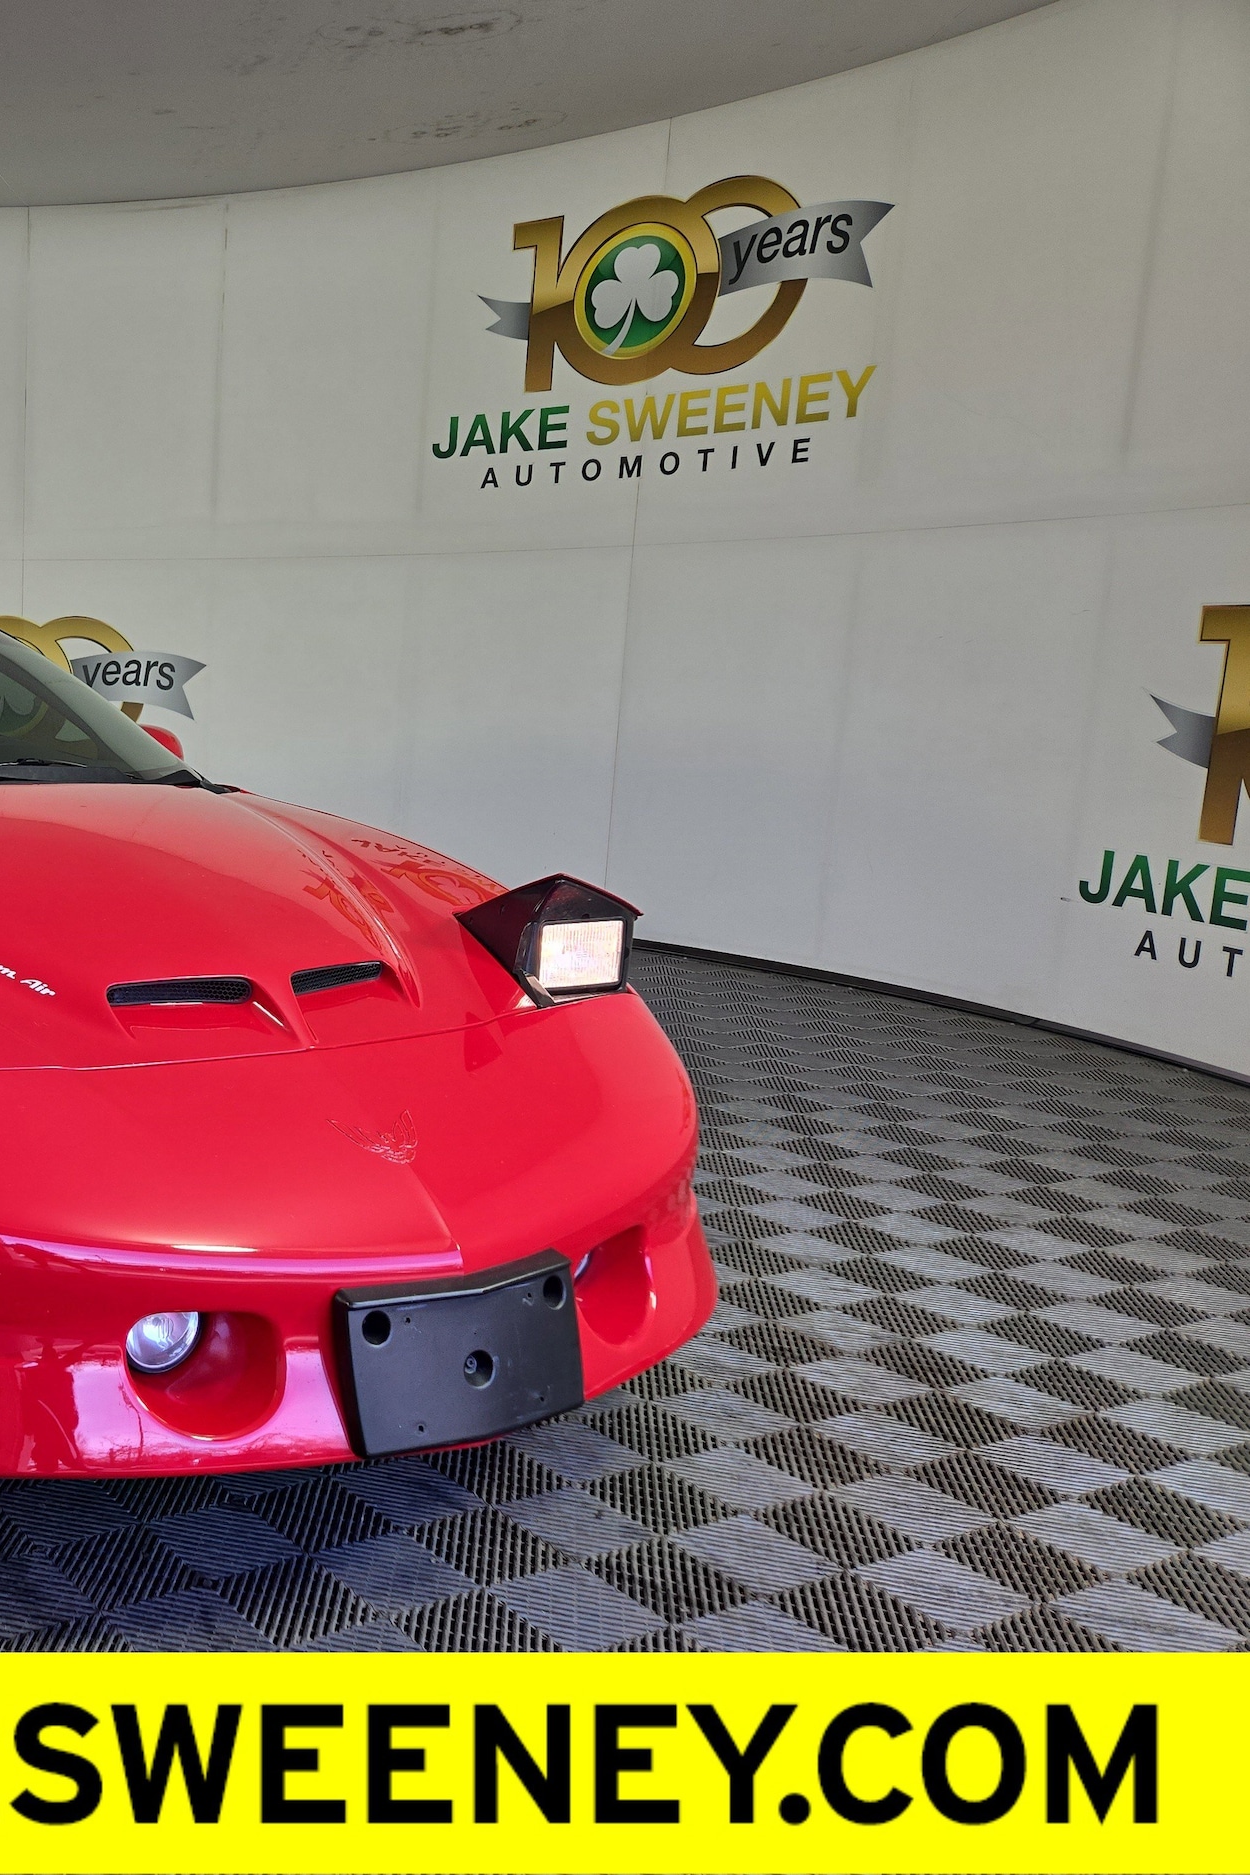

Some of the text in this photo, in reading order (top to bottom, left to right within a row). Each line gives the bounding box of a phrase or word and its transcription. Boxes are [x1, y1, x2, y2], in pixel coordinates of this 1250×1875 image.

[728, 213, 853, 286] years
[432, 365, 877, 459] JAKE SWEENEY
[481, 438, 811, 489] AUTOMOTIVE
[1078, 849, 1250, 932] JAKE
[19, 979, 56, 996] Air
